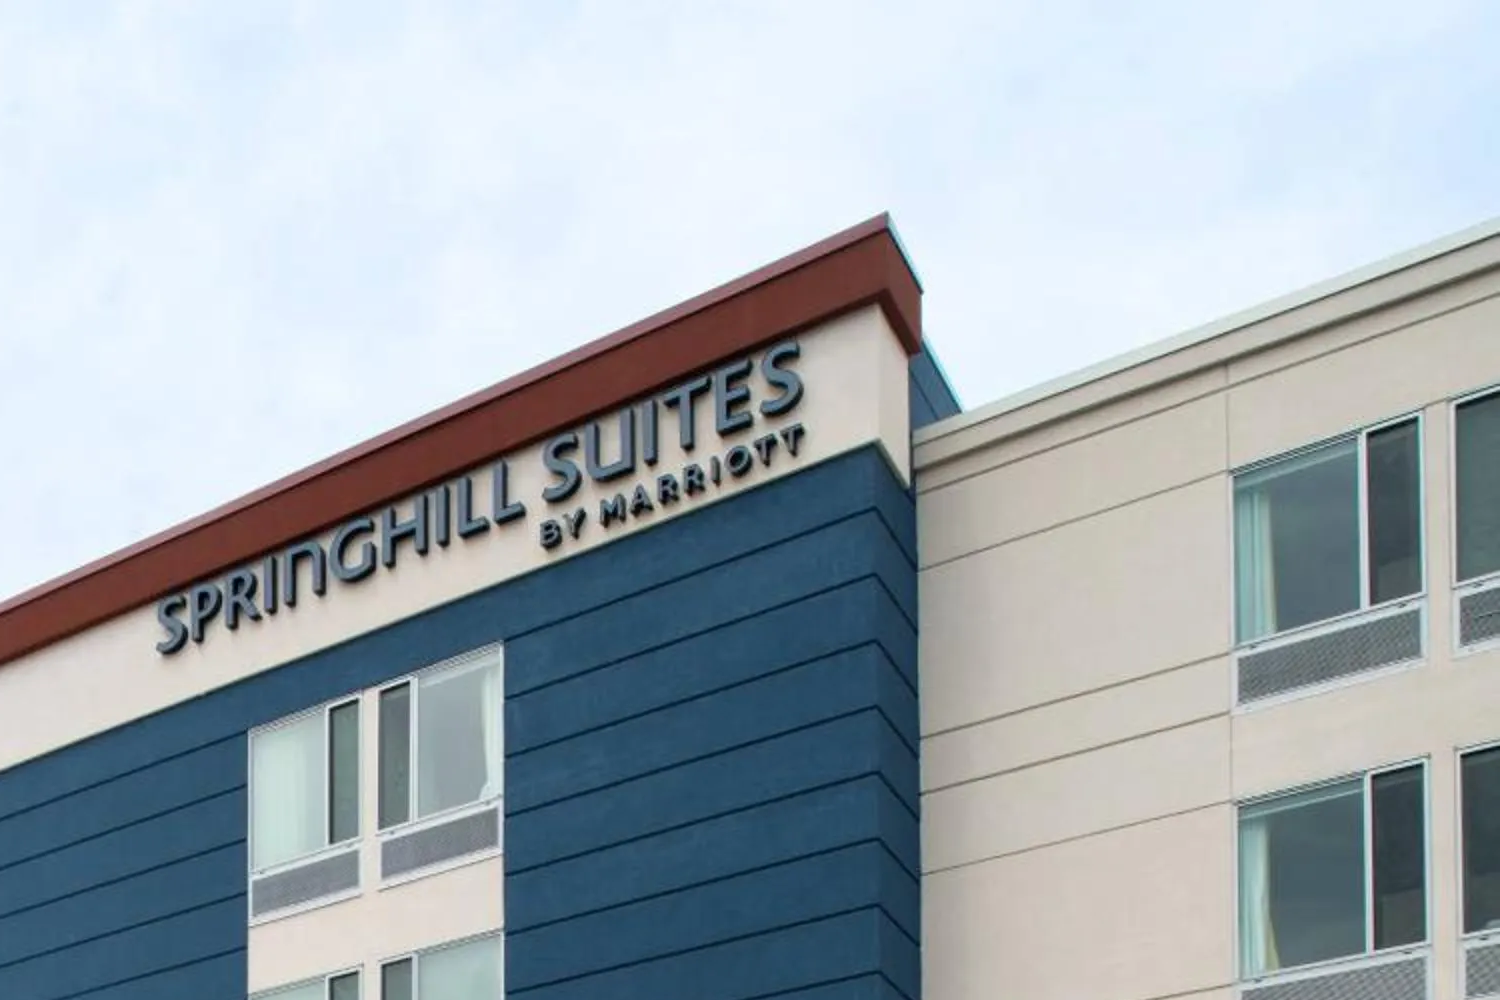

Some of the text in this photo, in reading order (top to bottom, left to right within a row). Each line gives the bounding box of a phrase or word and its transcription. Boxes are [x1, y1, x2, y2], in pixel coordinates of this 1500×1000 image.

[156, 341, 804, 656] SPRINGHILL SUITES
[540, 424, 804, 549] BY MARRIOTT
